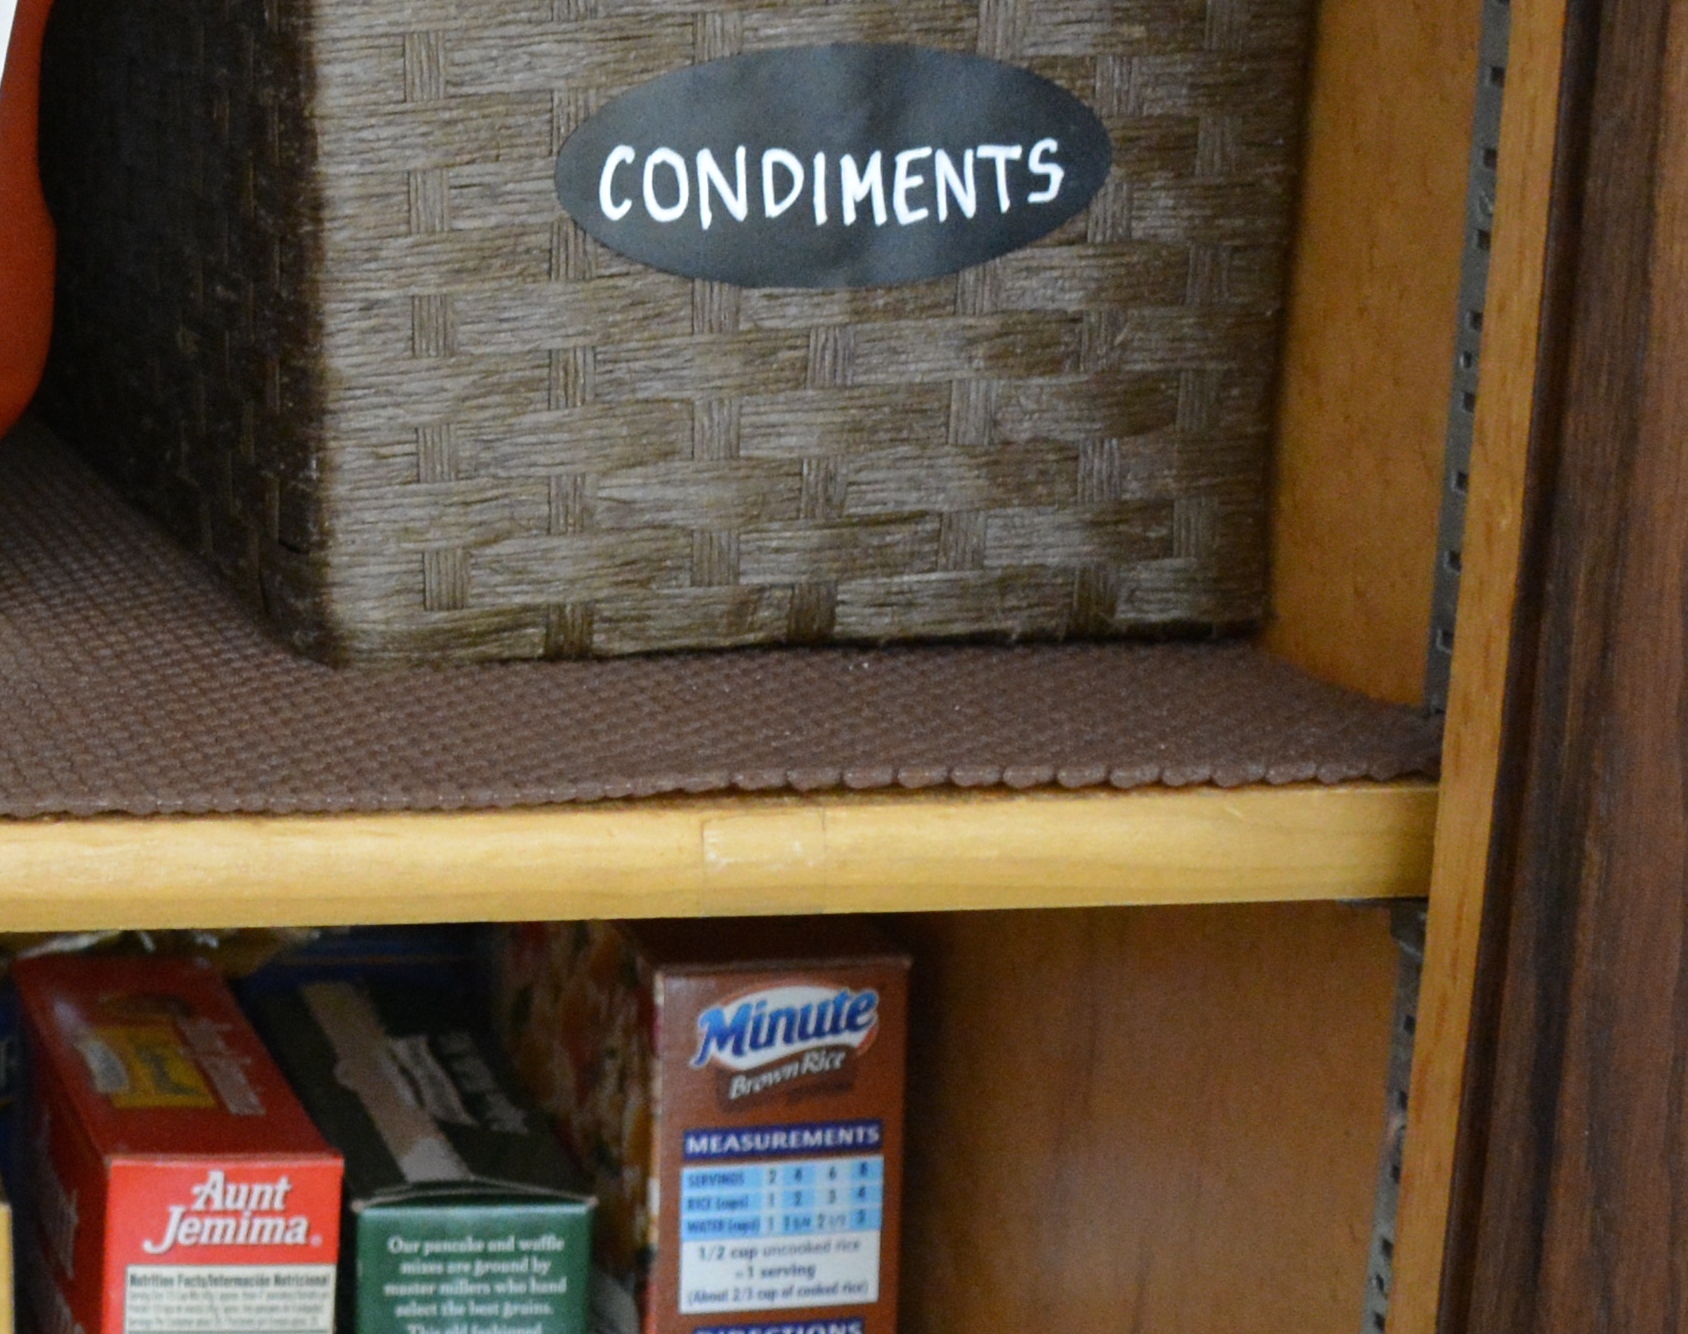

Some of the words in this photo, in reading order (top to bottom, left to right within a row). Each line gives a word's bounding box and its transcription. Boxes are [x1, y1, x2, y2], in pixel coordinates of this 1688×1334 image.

[598, 137, 1065, 230] CONDIMENTS
[690, 987, 879, 1068] Minute
[728, 1063, 797, 1100] Brown
[800, 1048, 847, 1077] Rice
[686, 1124, 880, 1155] MEASUREMENTS
[192, 1169, 292, 1212] Aunt
[143, 1206, 309, 1254] Jemima
[387, 1236, 420, 1254] Our
[423, 1235, 485, 1256] pancake
[488, 1235, 515, 1252] and
[519, 1234, 565, 1252] waffle
[730, 1246, 758, 1260] cup
[763, 1238, 832, 1257] uncooked
[475, 1255, 529, 1278] ground
[531, 1256, 552, 1276] by
[761, 1264, 817, 1280] serving
[494, 1278, 526, 1294] who
[530, 1276, 567, 1294] hand
[440, 1299, 467, 1316] the
[469, 1299, 499, 1316] best
